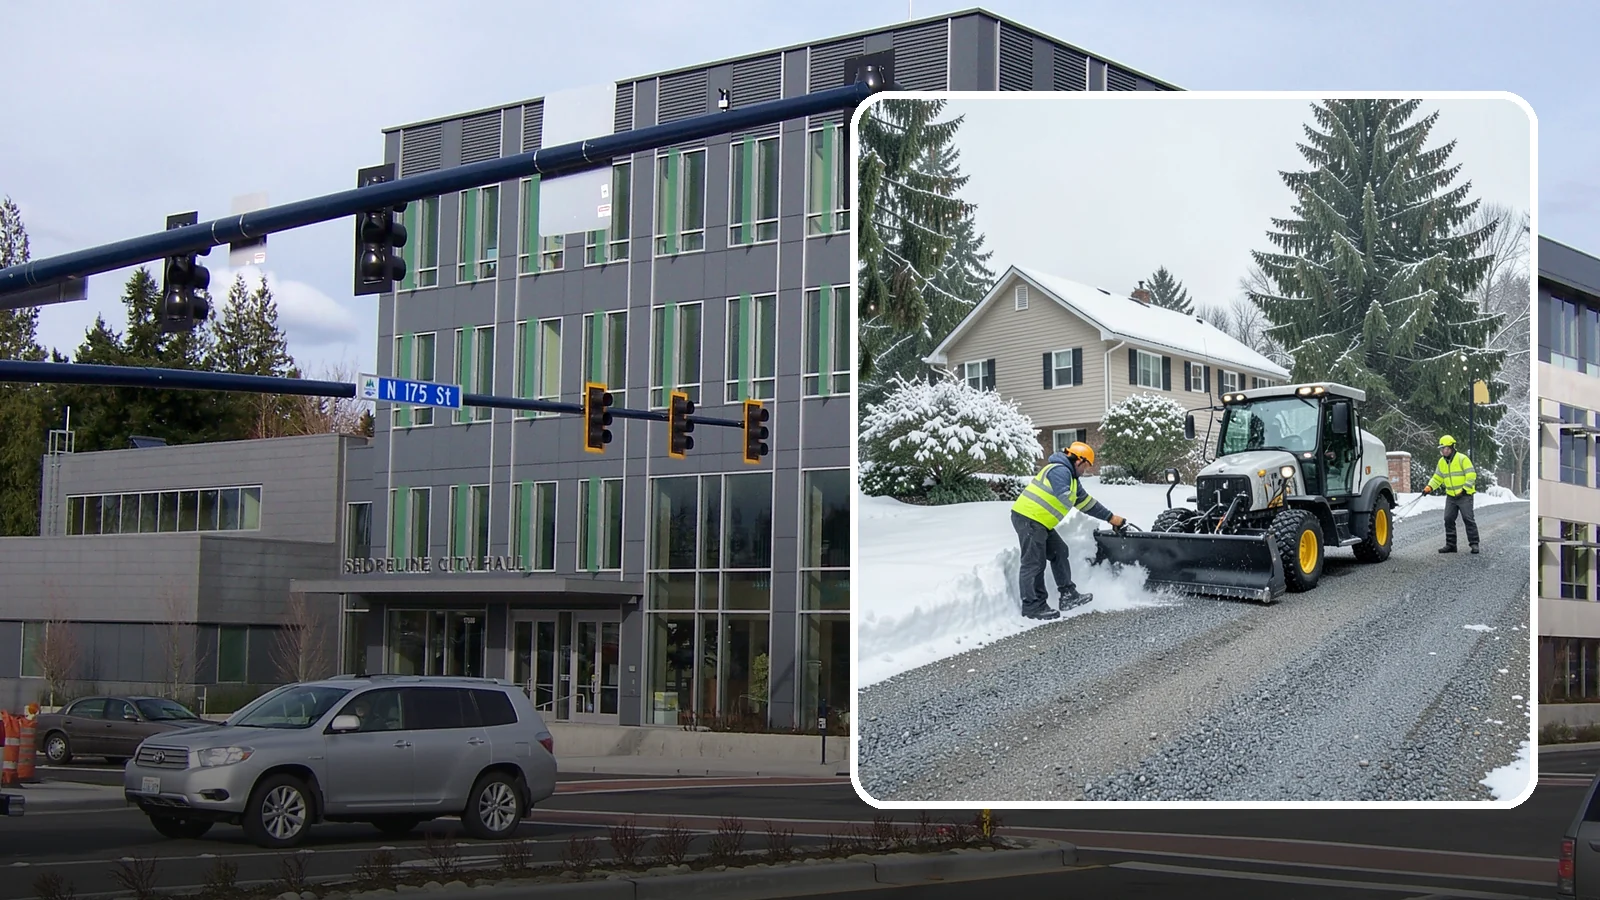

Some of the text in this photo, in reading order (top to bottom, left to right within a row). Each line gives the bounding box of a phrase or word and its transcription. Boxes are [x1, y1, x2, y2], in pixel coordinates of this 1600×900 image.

[387, 380, 451, 406] N 175 St
[344, 555, 525, 574] SHORELINE CITY HALL
